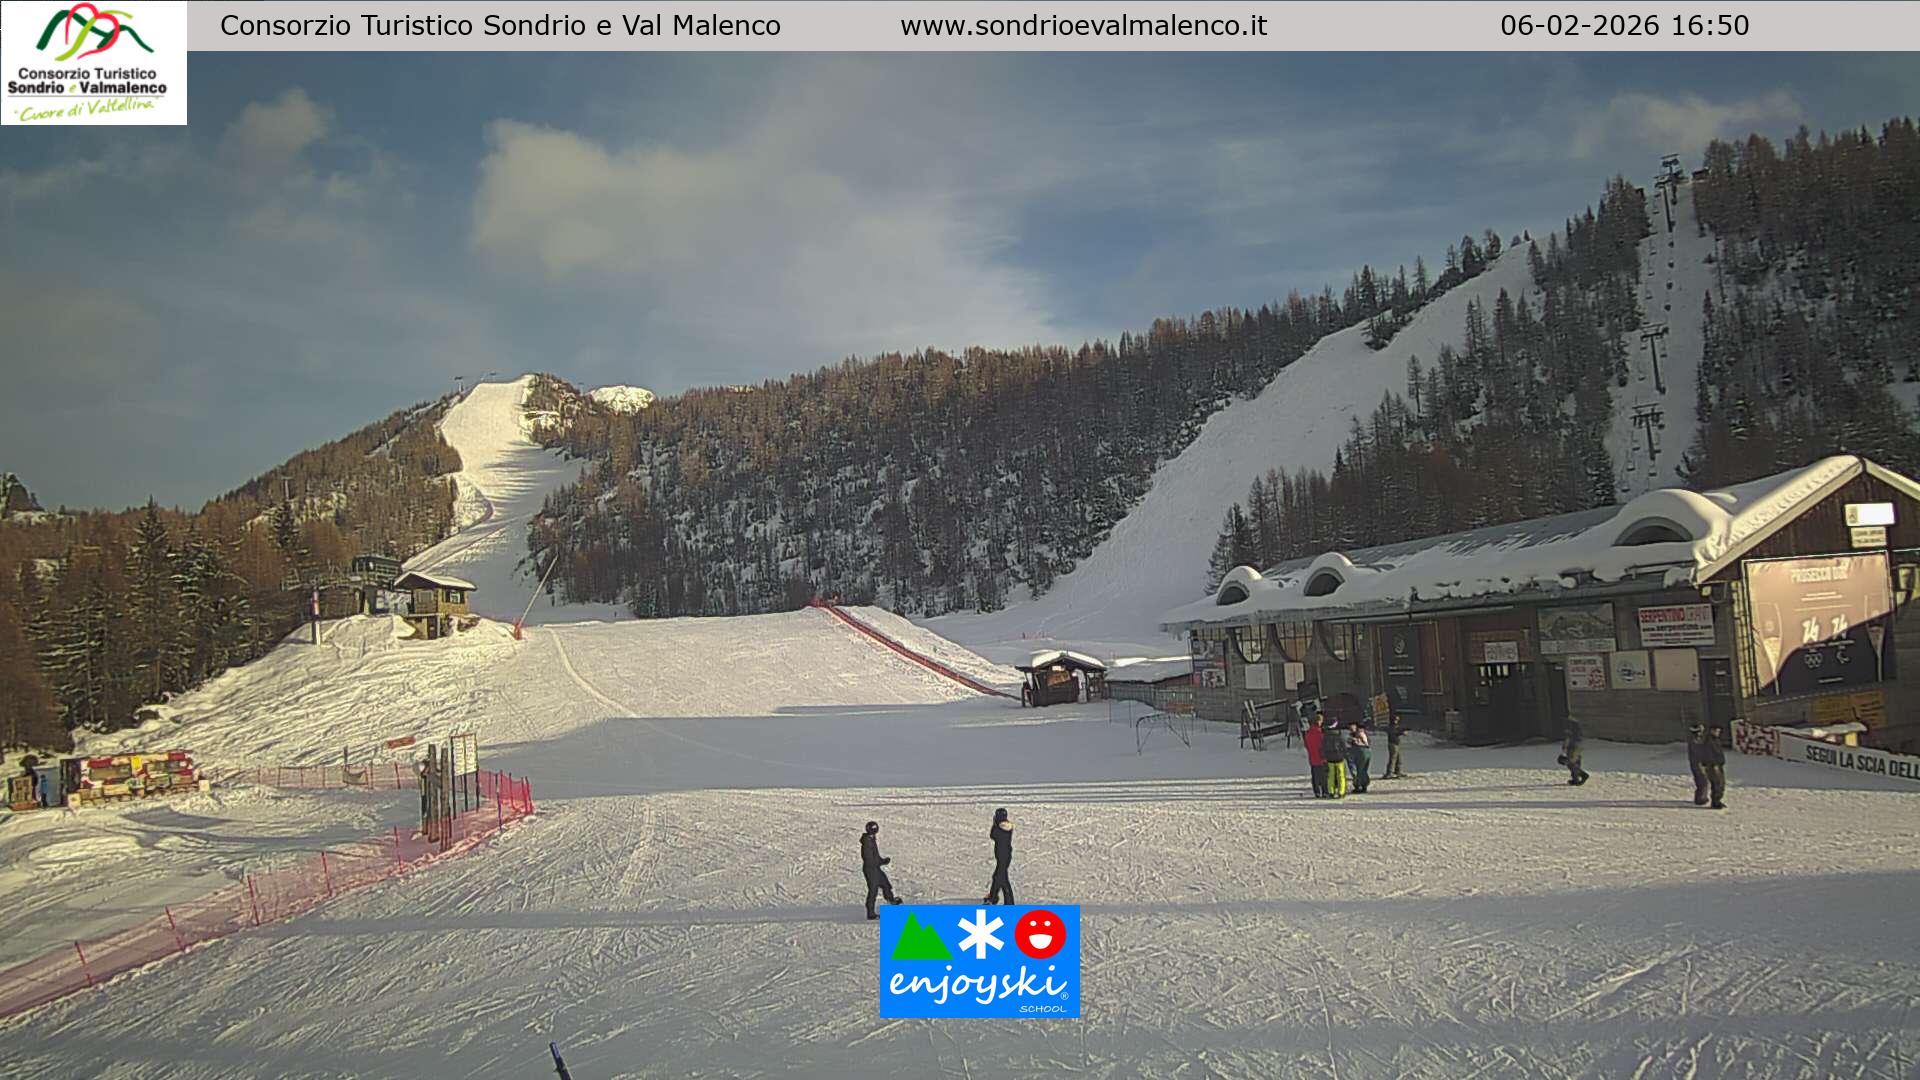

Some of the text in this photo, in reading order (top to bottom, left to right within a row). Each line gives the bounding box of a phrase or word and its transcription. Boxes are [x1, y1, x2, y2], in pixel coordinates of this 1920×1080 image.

[1806, 745, 1837, 766] SEGUI
[1839, 751, 1855, 770] LA
[1856, 755, 1886, 775] SCIA
